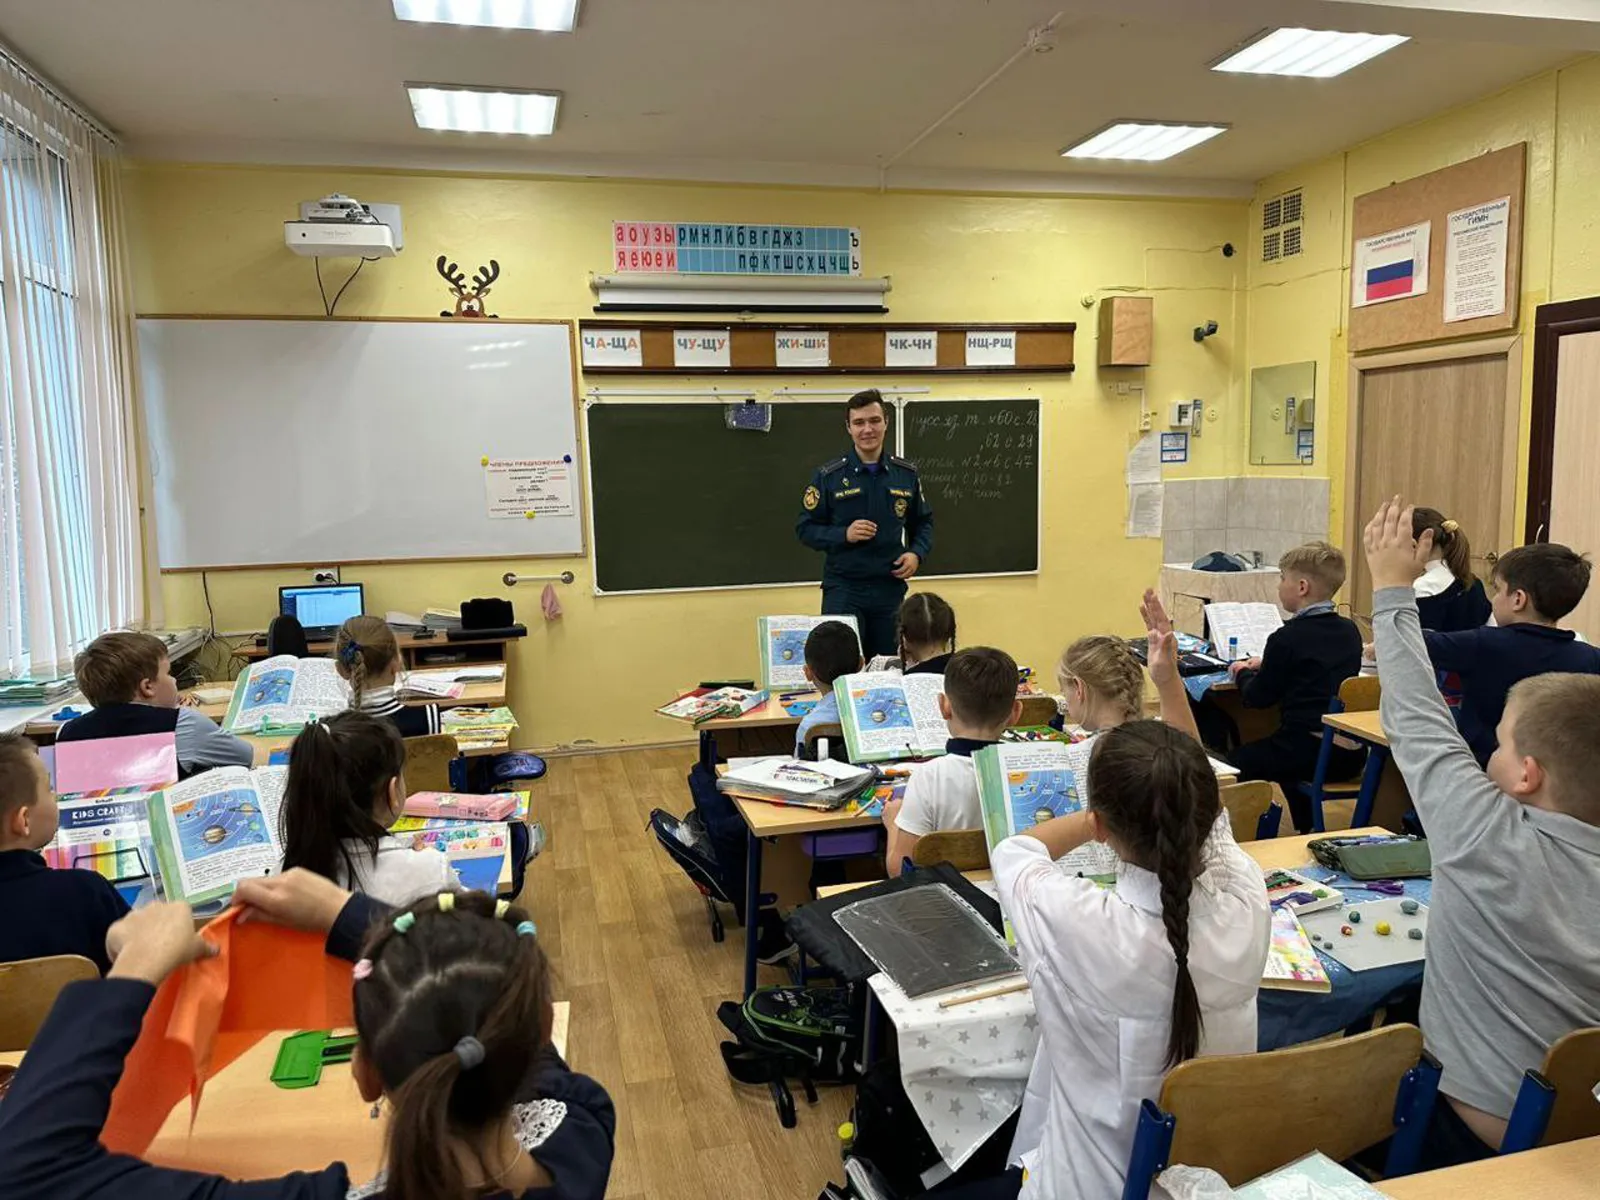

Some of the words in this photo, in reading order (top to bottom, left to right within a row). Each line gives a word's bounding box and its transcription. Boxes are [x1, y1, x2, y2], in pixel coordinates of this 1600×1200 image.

[584, 336, 638, 350] ЧА-ЩА
[677, 338, 726, 351] ЧУ-ЩУ
[777, 338, 826, 350] ЖИ-ШИ
[889, 338, 932, 350] ЧК-ЧН
[968, 337, 1013, 350] НЩ-РЩ
[72, 809, 95, 820] KIDS
